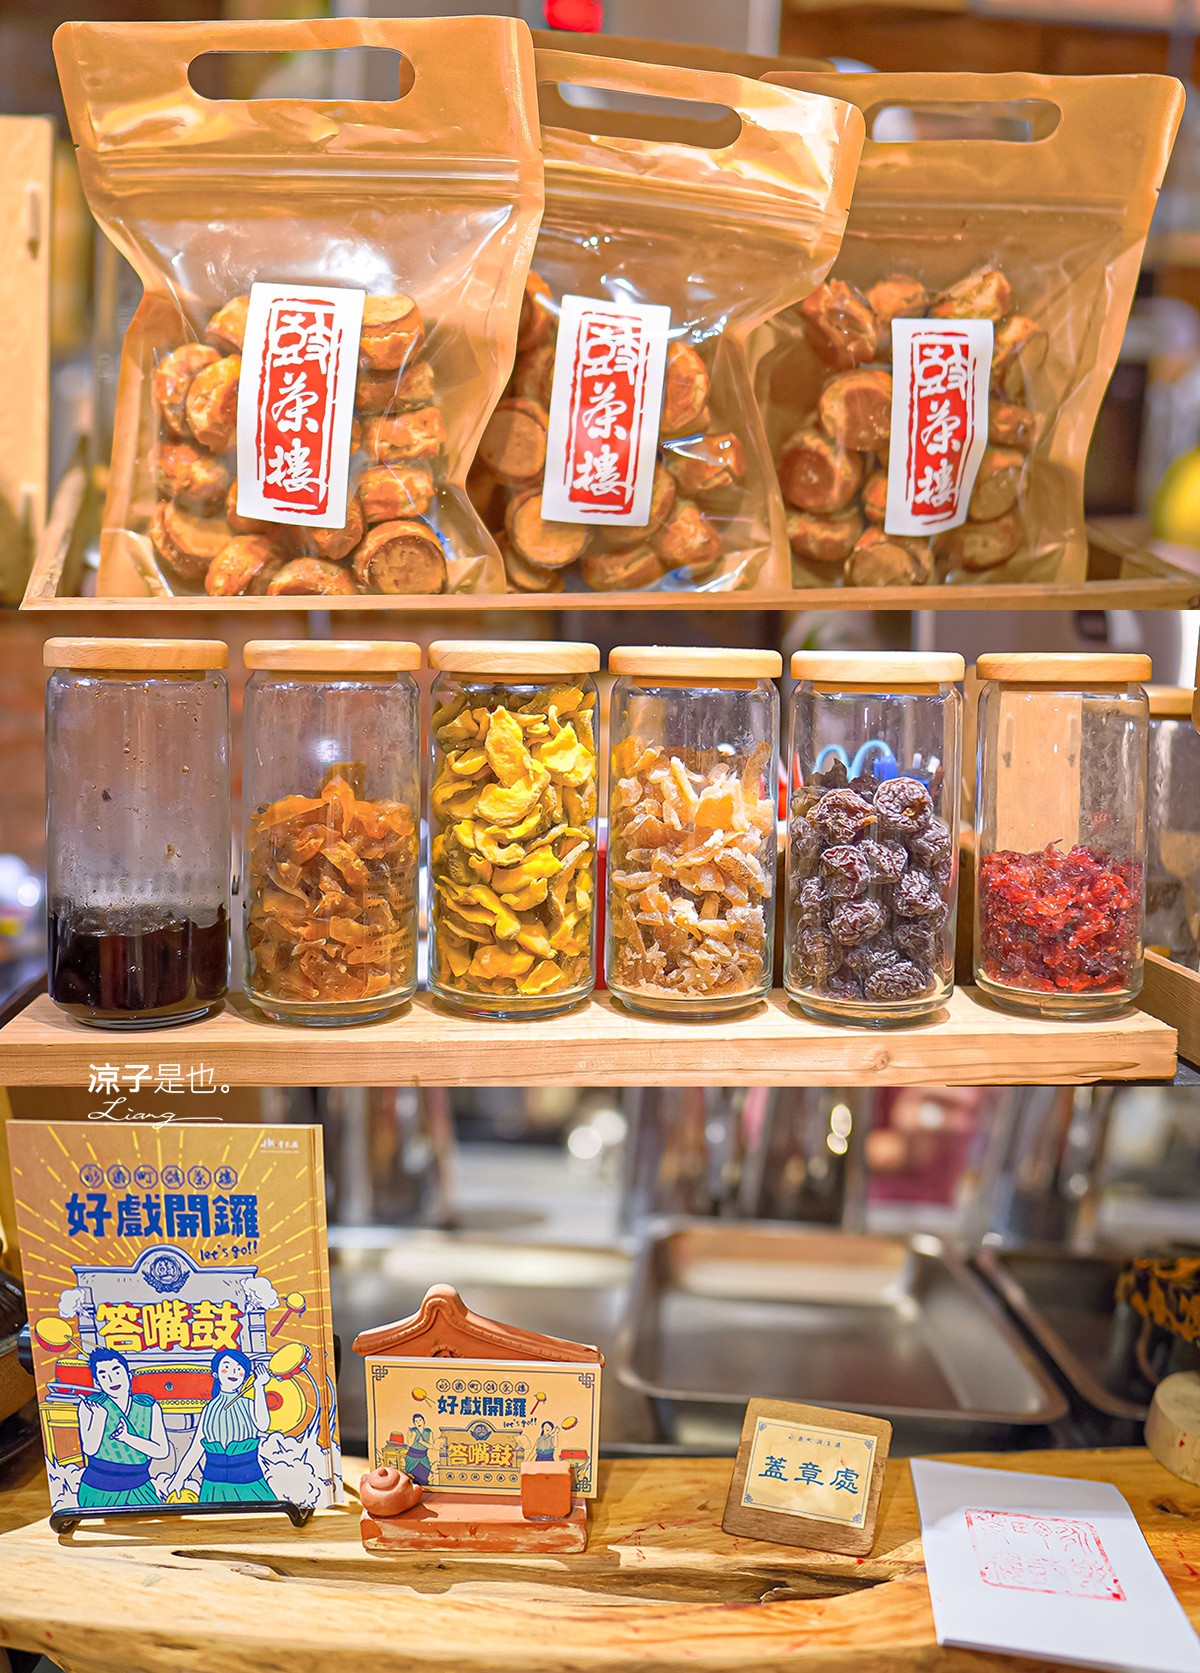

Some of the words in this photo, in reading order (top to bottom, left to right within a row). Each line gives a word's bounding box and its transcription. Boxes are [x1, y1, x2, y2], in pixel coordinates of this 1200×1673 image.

[65, 1193, 260, 1238] 好戲開鑼
[96, 1300, 242, 1353] 答嘴鼓
[437, 1395, 527, 1417] 好戲開鑼
[448, 1442, 515, 1467] 答嘴鼓
[758, 1455, 859, 1494] 蓋章處
